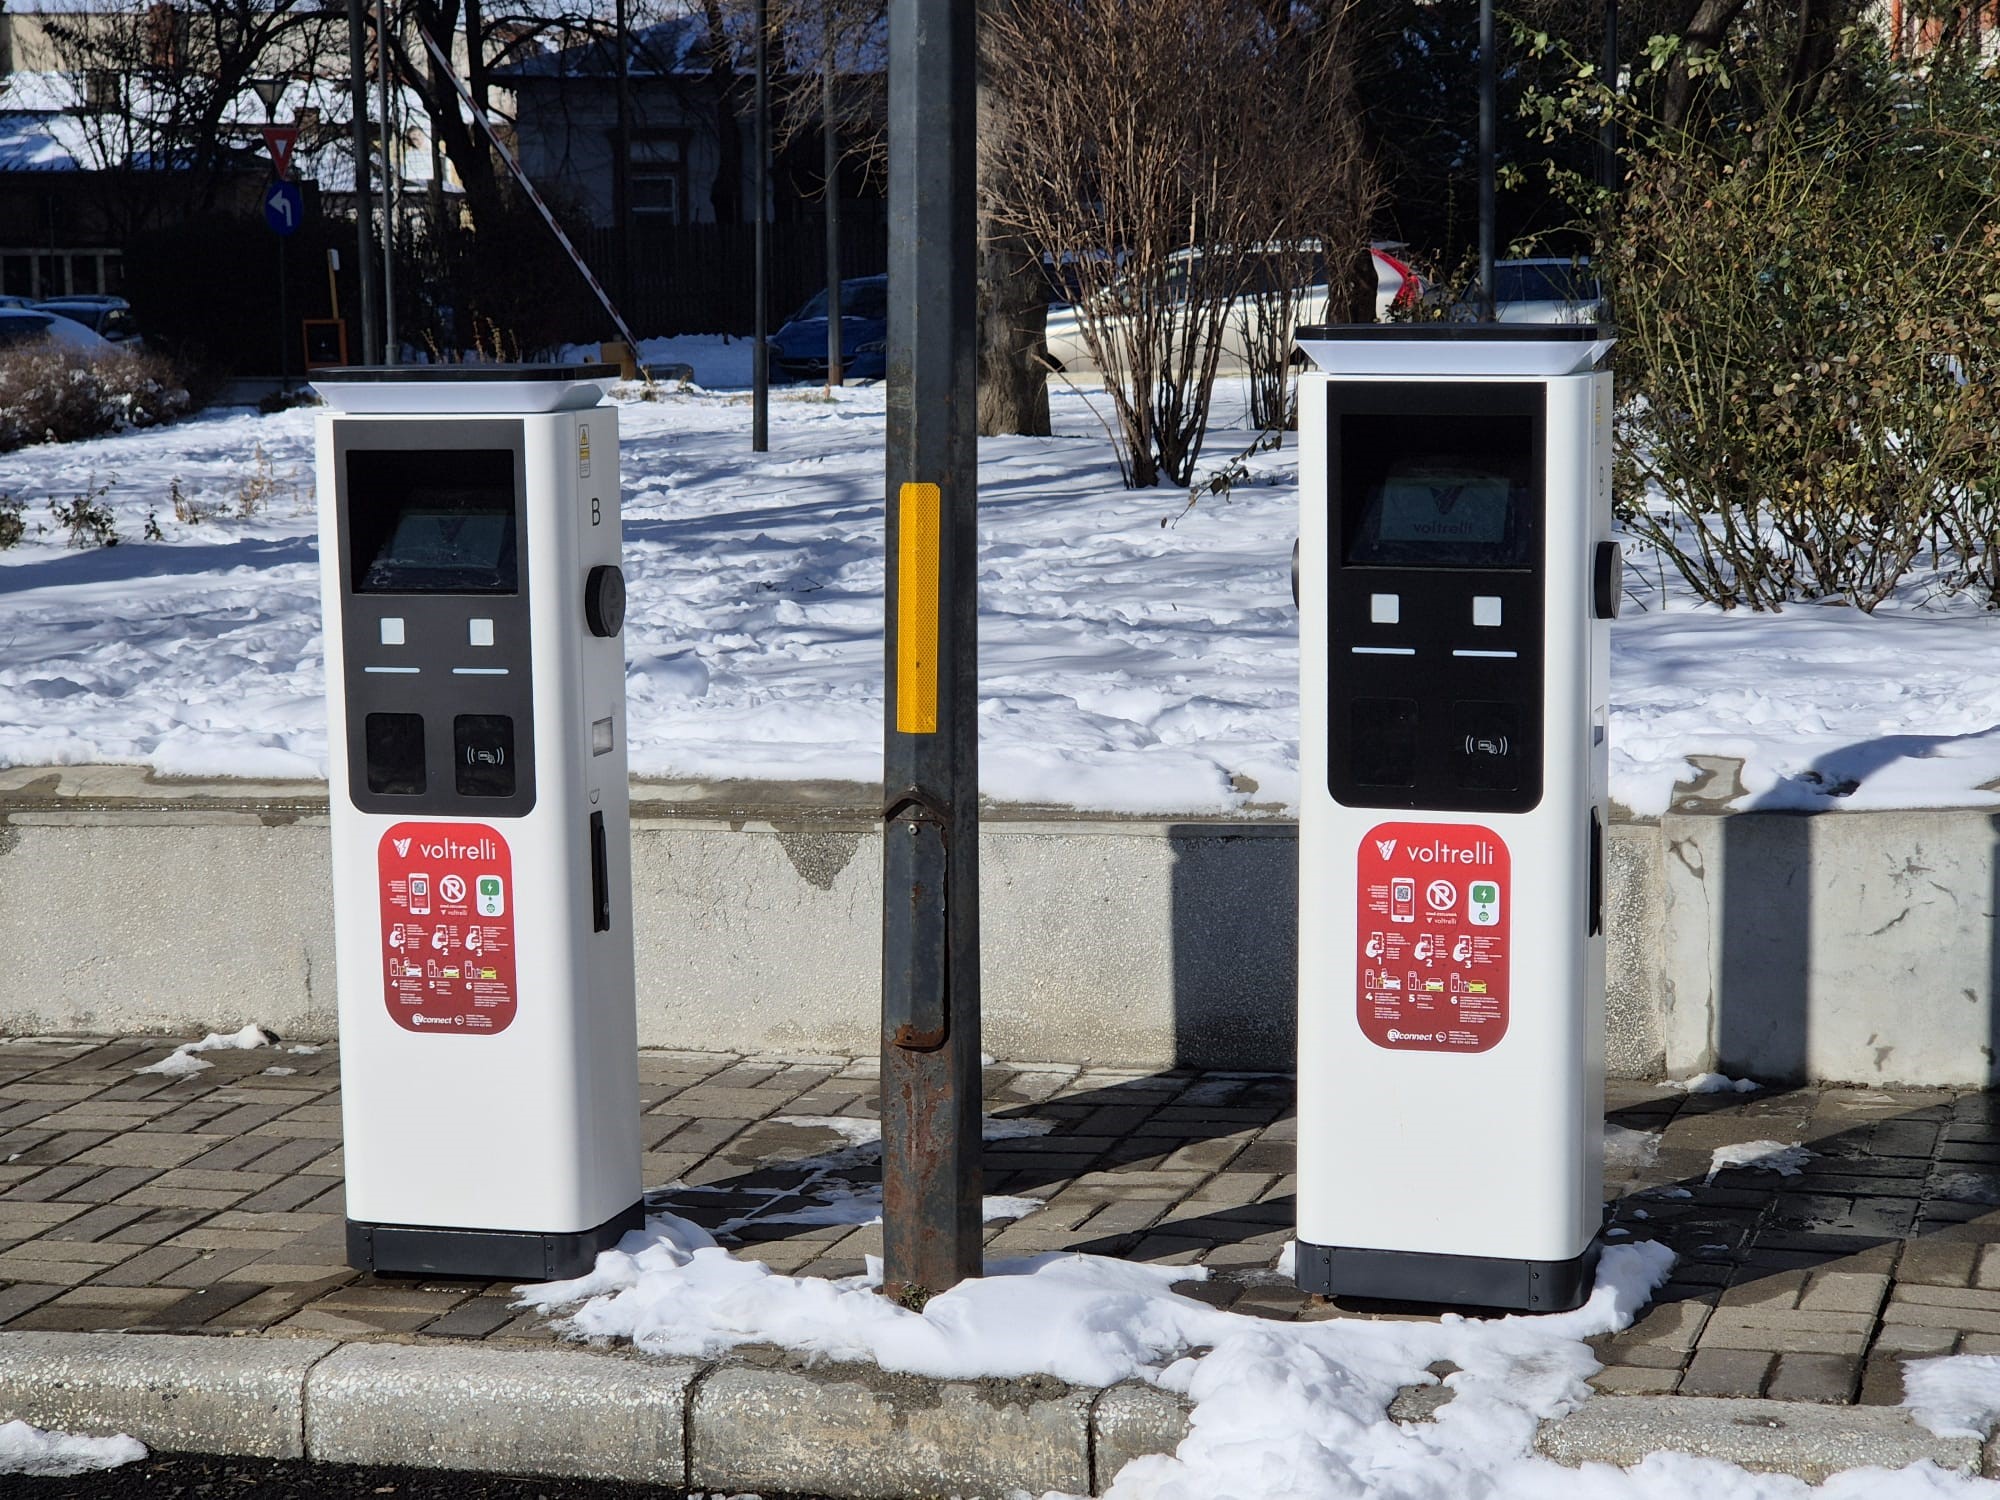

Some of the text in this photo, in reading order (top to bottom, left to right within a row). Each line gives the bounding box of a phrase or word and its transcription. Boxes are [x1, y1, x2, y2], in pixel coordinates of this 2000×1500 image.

[591, 497, 601, 527] B
[1413, 519, 1473, 535] voltrelli
[420, 837, 496, 860] voltrelli
[1406, 839, 1494, 865] voltrelli
[399, 946, 405, 954] 1
[442, 948, 449, 956] 2
[476, 949, 483, 957] 3
[1376, 956, 1382, 965] 1
[1426, 959, 1433, 968] 2
[1465, 960, 1472, 969] 3
[391, 980, 398, 988] 4
[428, 981, 435, 989] 5
[465, 982, 472, 990] 6
[1365, 992, 1373, 1001] 4
[1408, 994, 1415, 1002] 5
[1450, 996, 1458, 1005] 6
